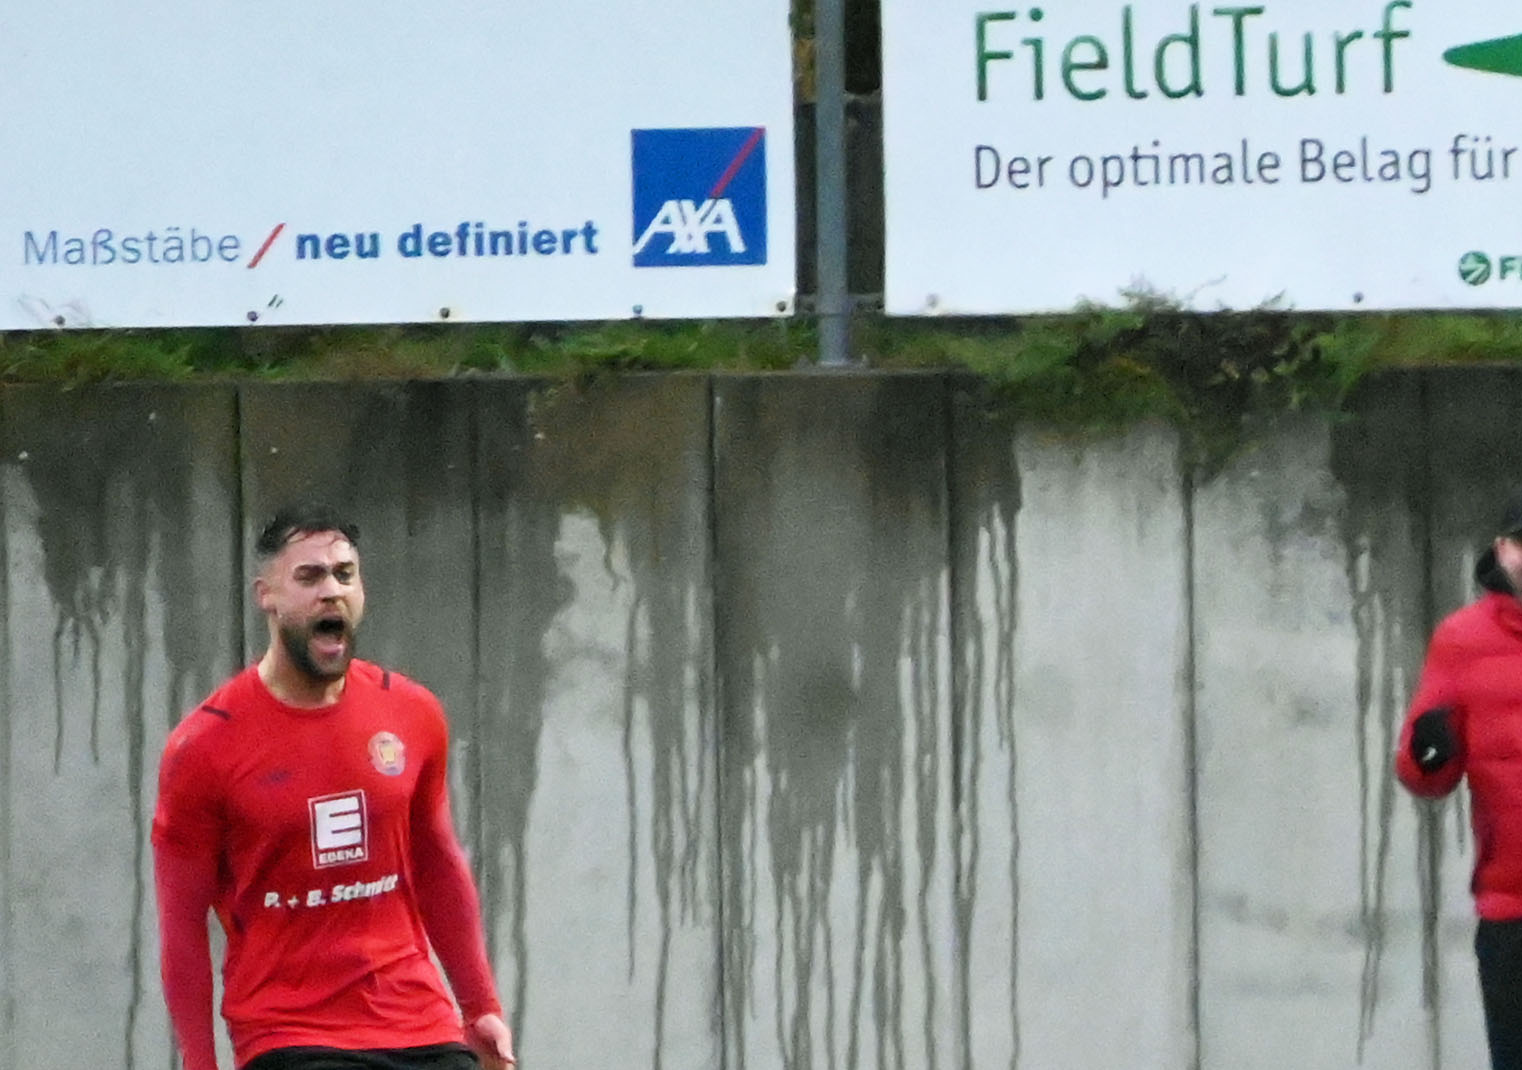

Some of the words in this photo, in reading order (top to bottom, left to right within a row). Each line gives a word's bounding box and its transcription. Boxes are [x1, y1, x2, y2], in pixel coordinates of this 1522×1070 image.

[975, 1, 1411, 101] FieldTurf
[975, 145, 1052, 188] Der
[1068, 138, 1281, 198] optimale
[1301, 136, 1431, 193] Belag
[1449, 133, 1518, 180] für
[23, 227, 241, 268] Maßstäbe
[296, 230, 380, 260] neu
[398, 220, 600, 259] definiert
[632, 198, 748, 255] AXA
[318, 847, 364, 864] EDEKA
